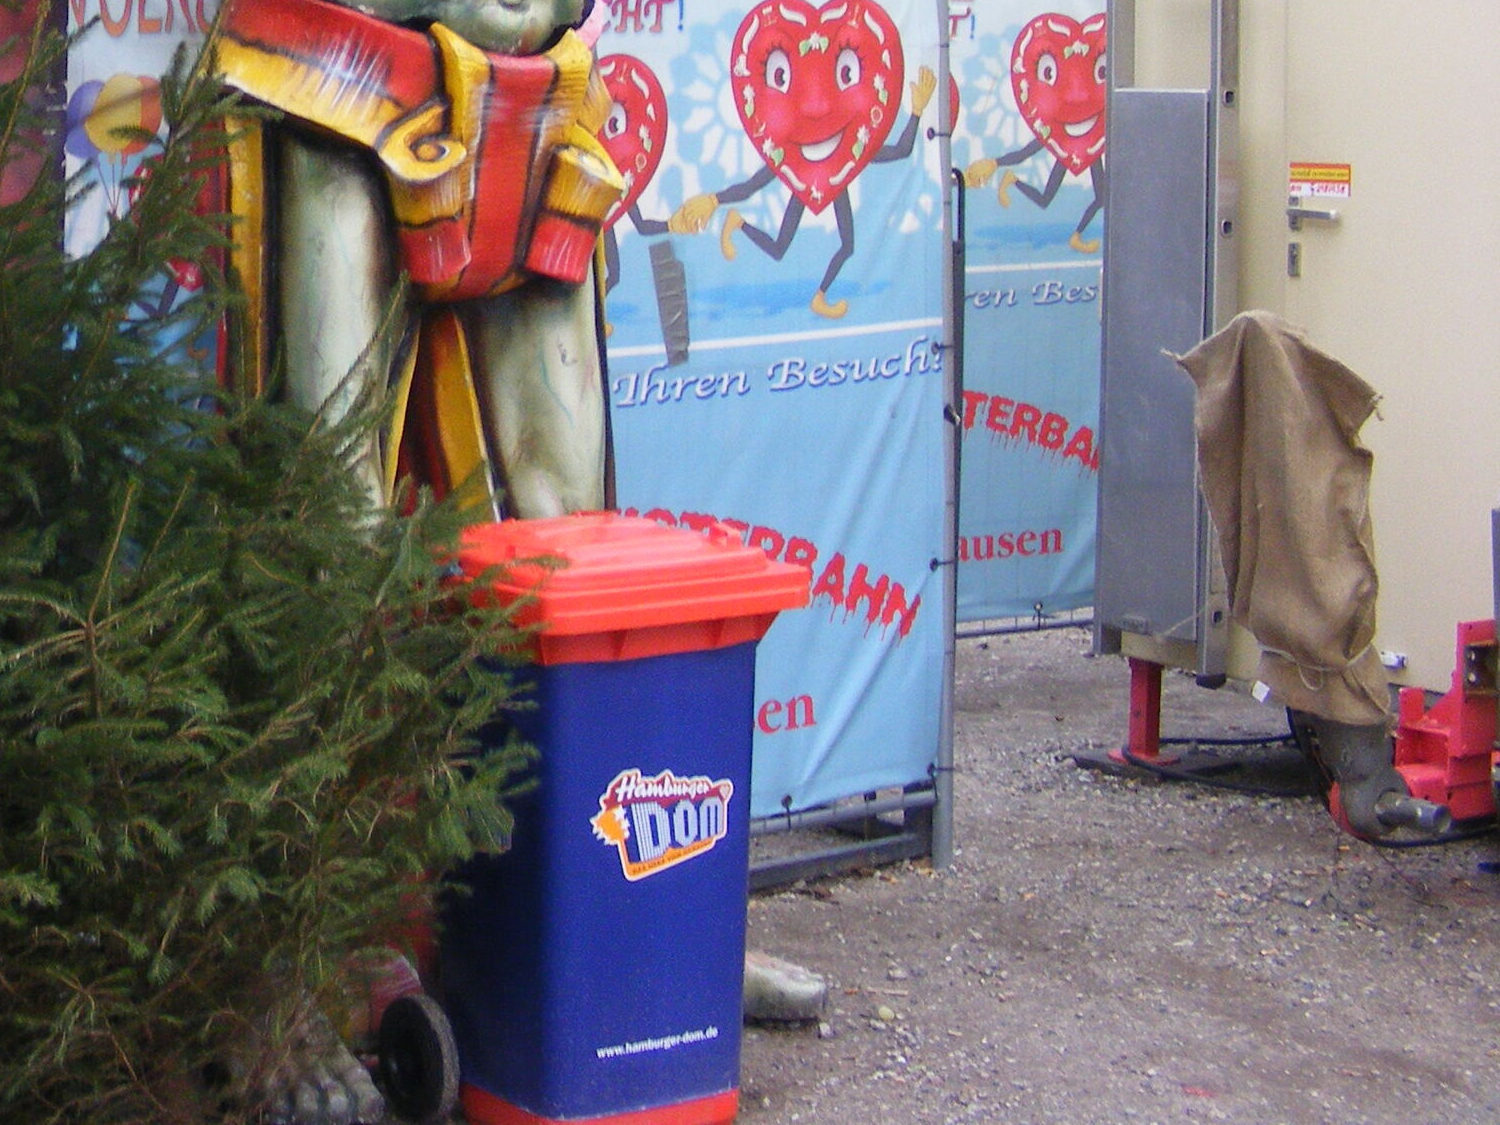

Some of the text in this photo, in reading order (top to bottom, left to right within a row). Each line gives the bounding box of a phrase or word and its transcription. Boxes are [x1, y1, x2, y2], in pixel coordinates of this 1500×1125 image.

[612, 360, 751, 408] Ihren
[615, 776, 711, 802] Hamburger
[630, 796, 725, 863] DOM
[596, 1025, 719, 1059] www.hamburger-dom.de
